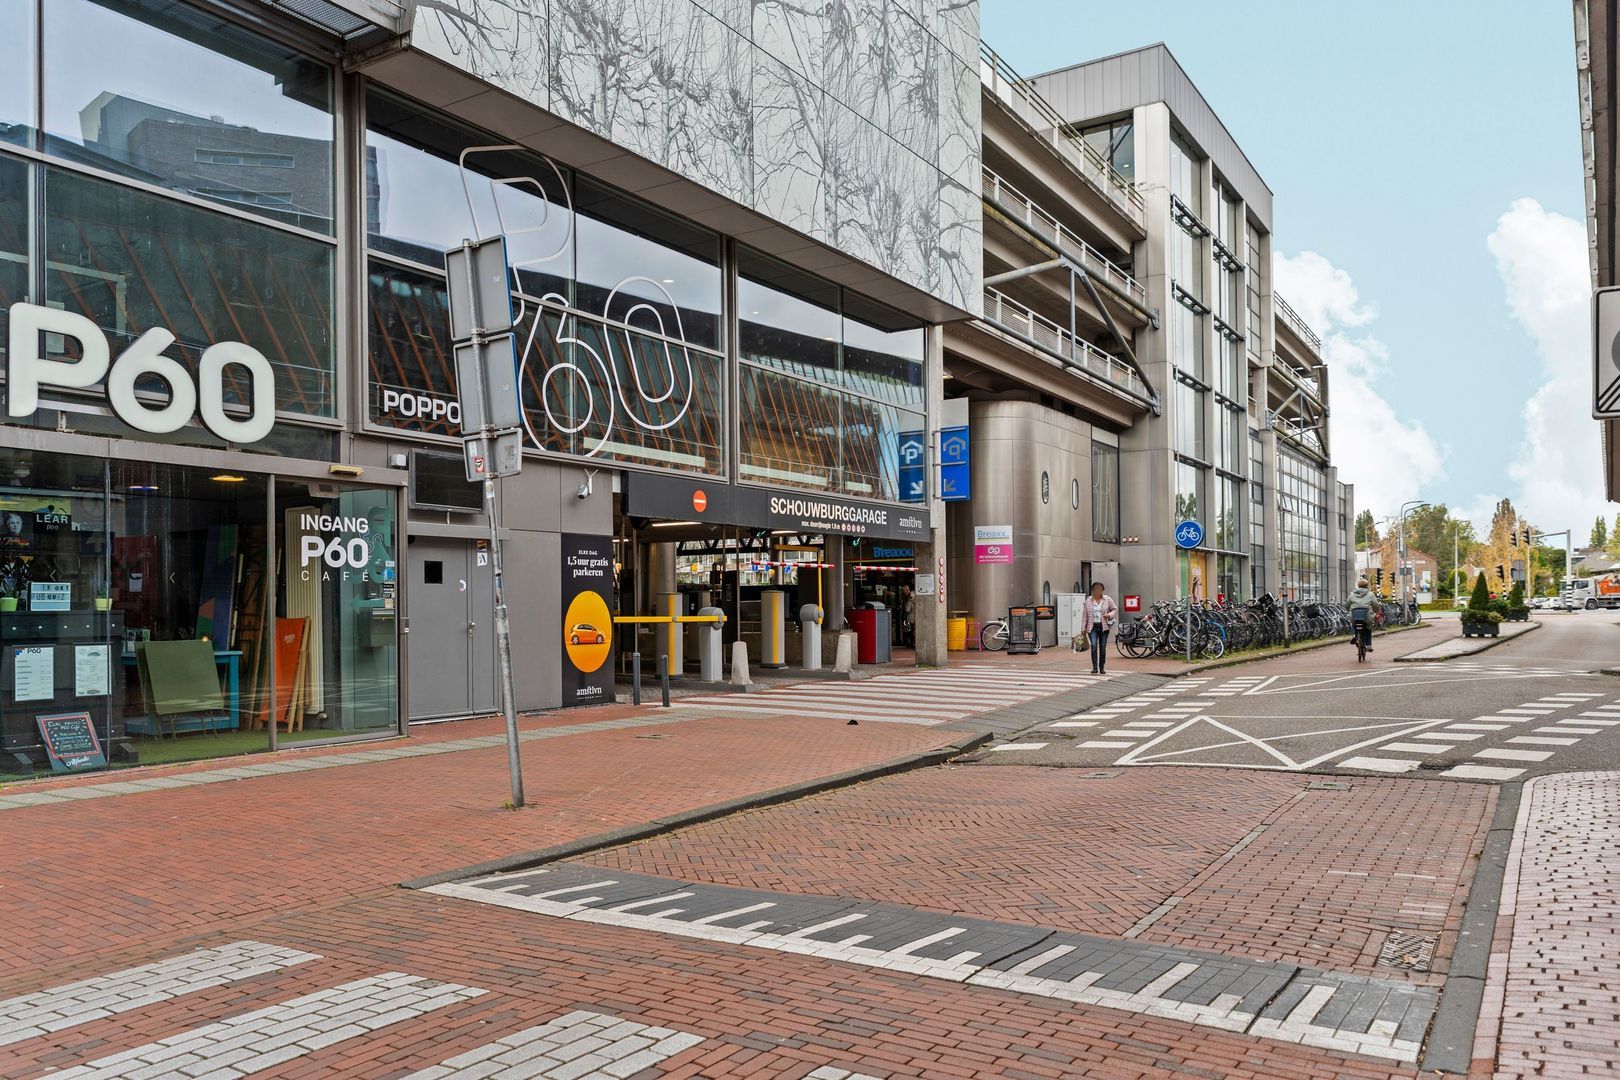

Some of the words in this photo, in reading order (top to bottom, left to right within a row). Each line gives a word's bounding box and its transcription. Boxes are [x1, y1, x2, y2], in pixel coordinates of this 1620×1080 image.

[8, 302, 276, 443] P60
[383, 389, 460, 424] POPPO
[771, 497, 887, 525] SCHOUWBURGGARAGE
[301, 514, 369, 533] INGANG
[301, 535, 369, 568] P60
[568, 556, 577, 566] 1,5
[590, 557, 608, 568] gratis
[301, 570, 369, 582] CAFÉ
[573, 567, 604, 578] parkeren
